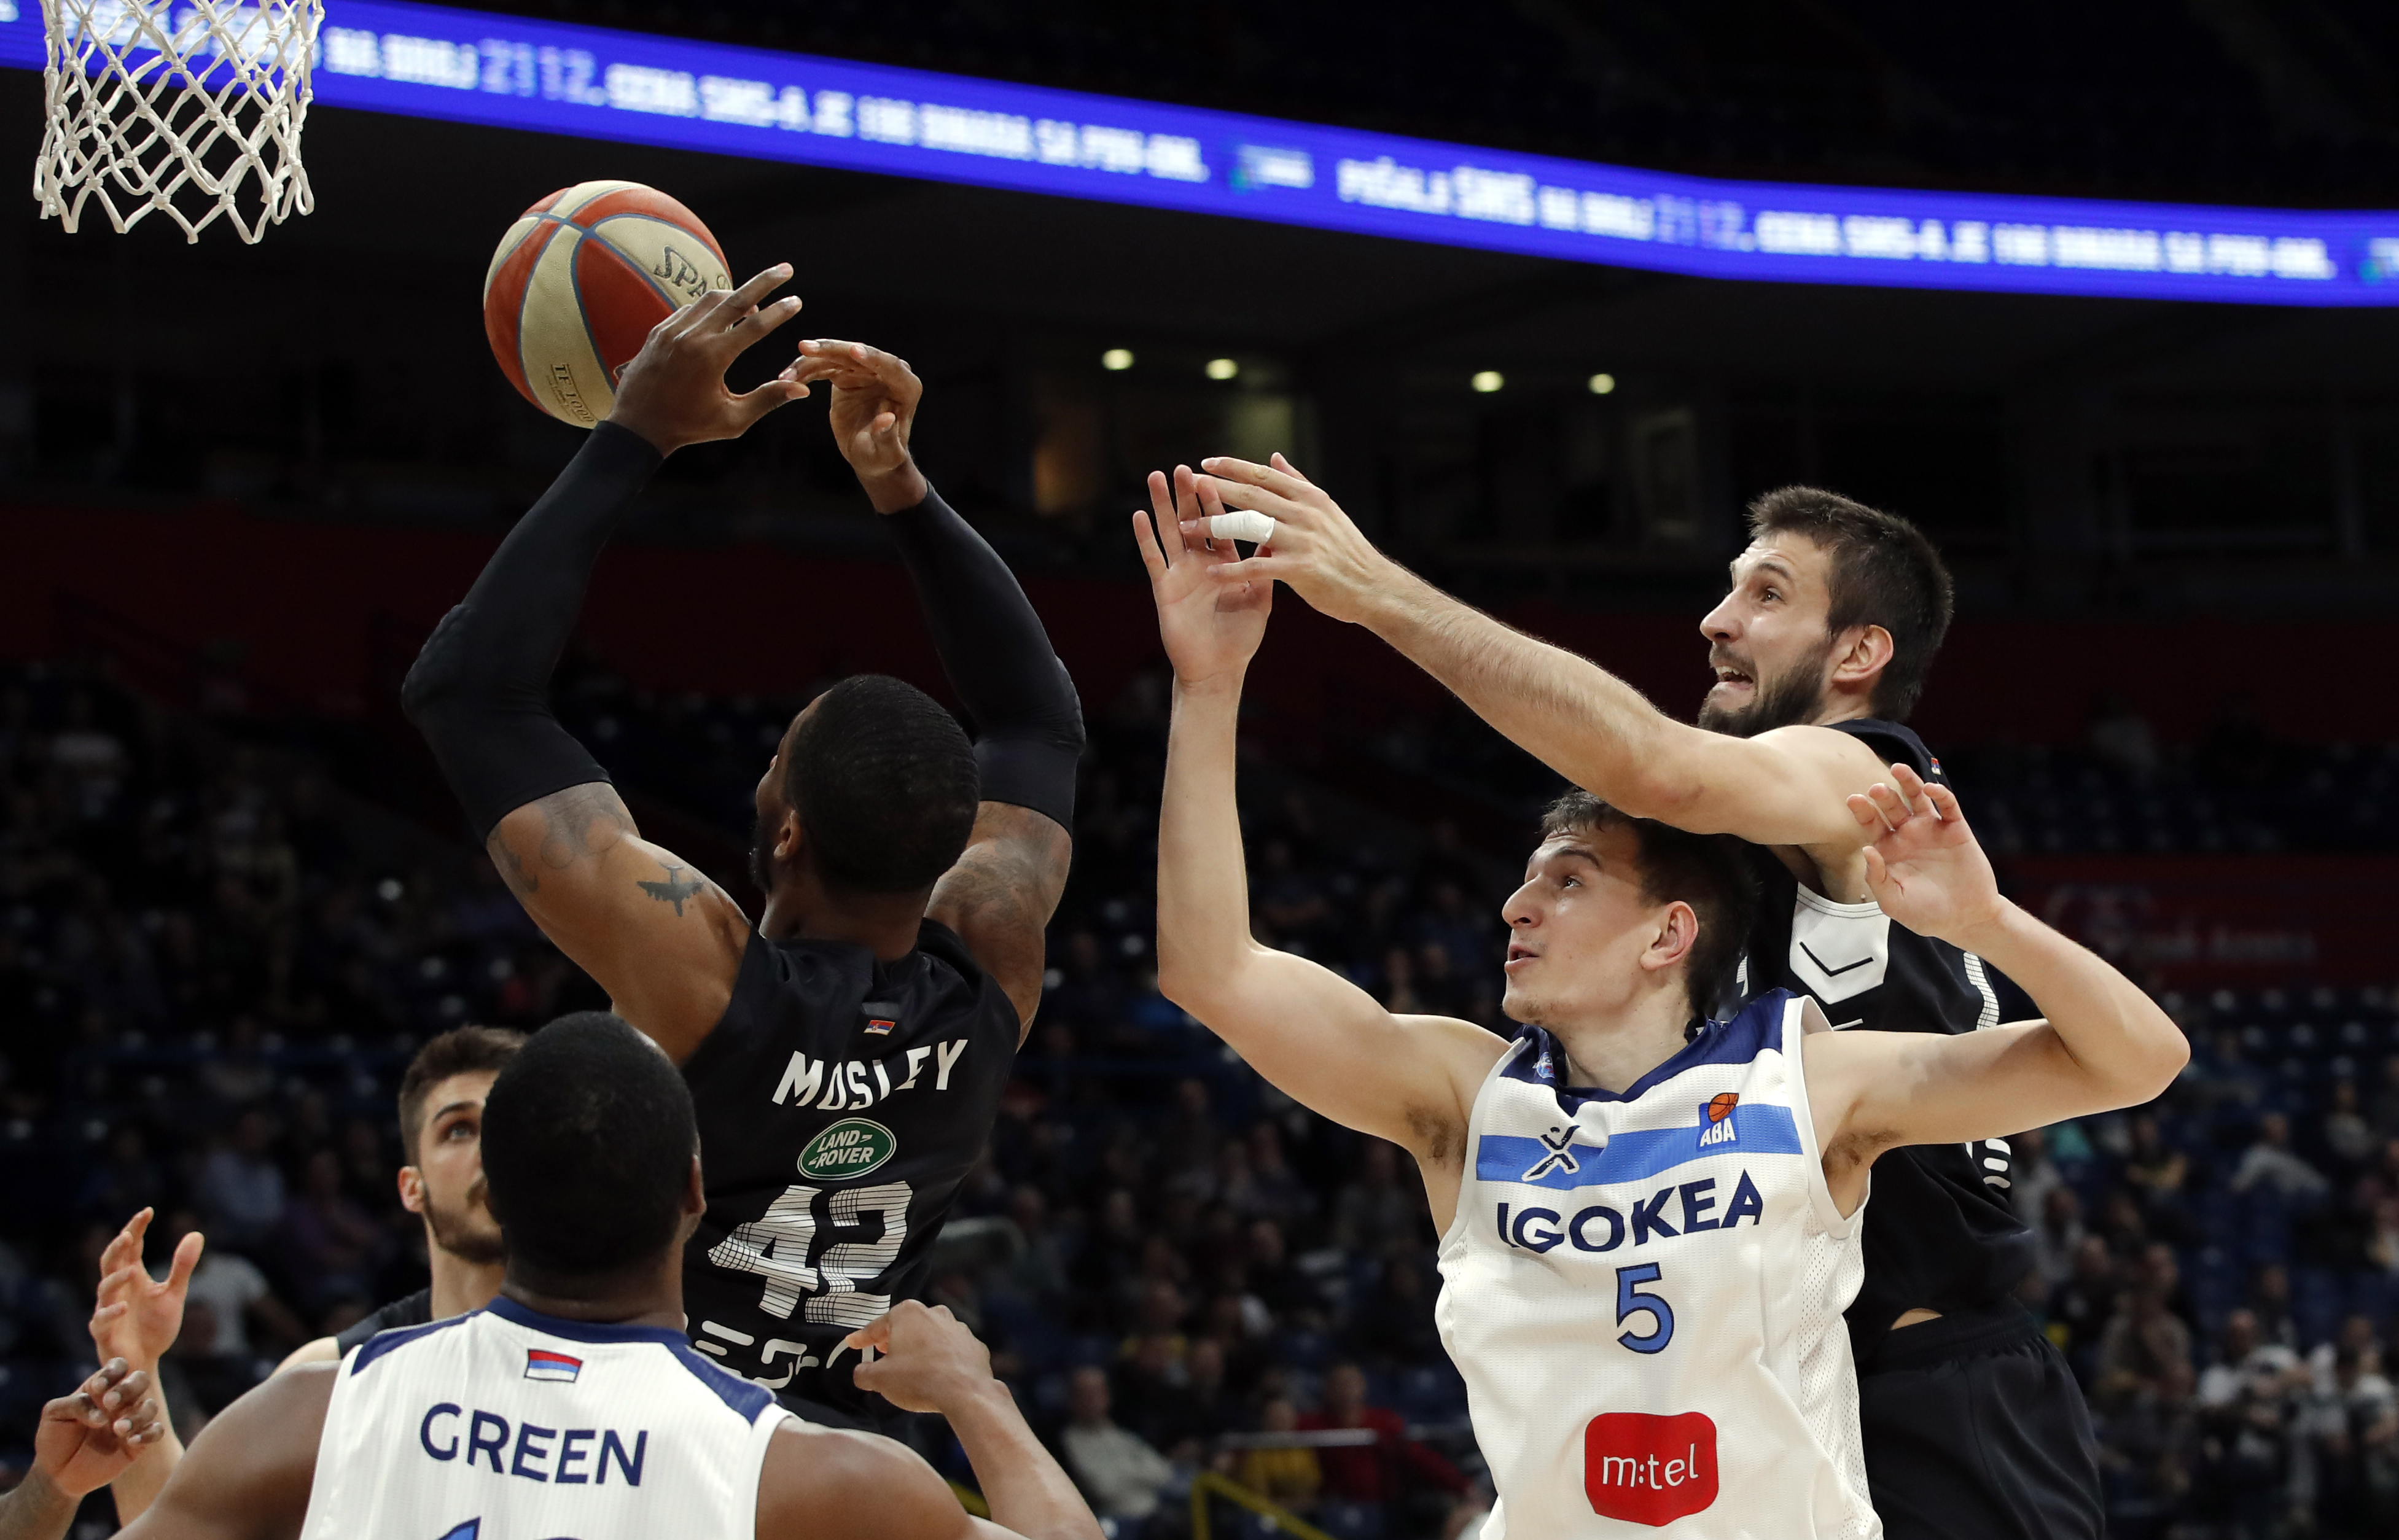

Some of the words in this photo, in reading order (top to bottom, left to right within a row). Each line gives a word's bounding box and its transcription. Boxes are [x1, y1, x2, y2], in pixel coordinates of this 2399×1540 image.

[771, 1039, 969, 1111] MOSLEY
[814, 1146, 875, 1169] ROVER
[817, 1130, 860, 1153] LAND
[1699, 1117, 1736, 1148] ABA
[1497, 1169, 1763, 1254] IGOKEA
[708, 1180, 913, 1329] 42
[1615, 1262, 1675, 1355] 5
[420, 1402, 649, 1487] GREEN
[1601, 1442, 1699, 1490] m:tel
